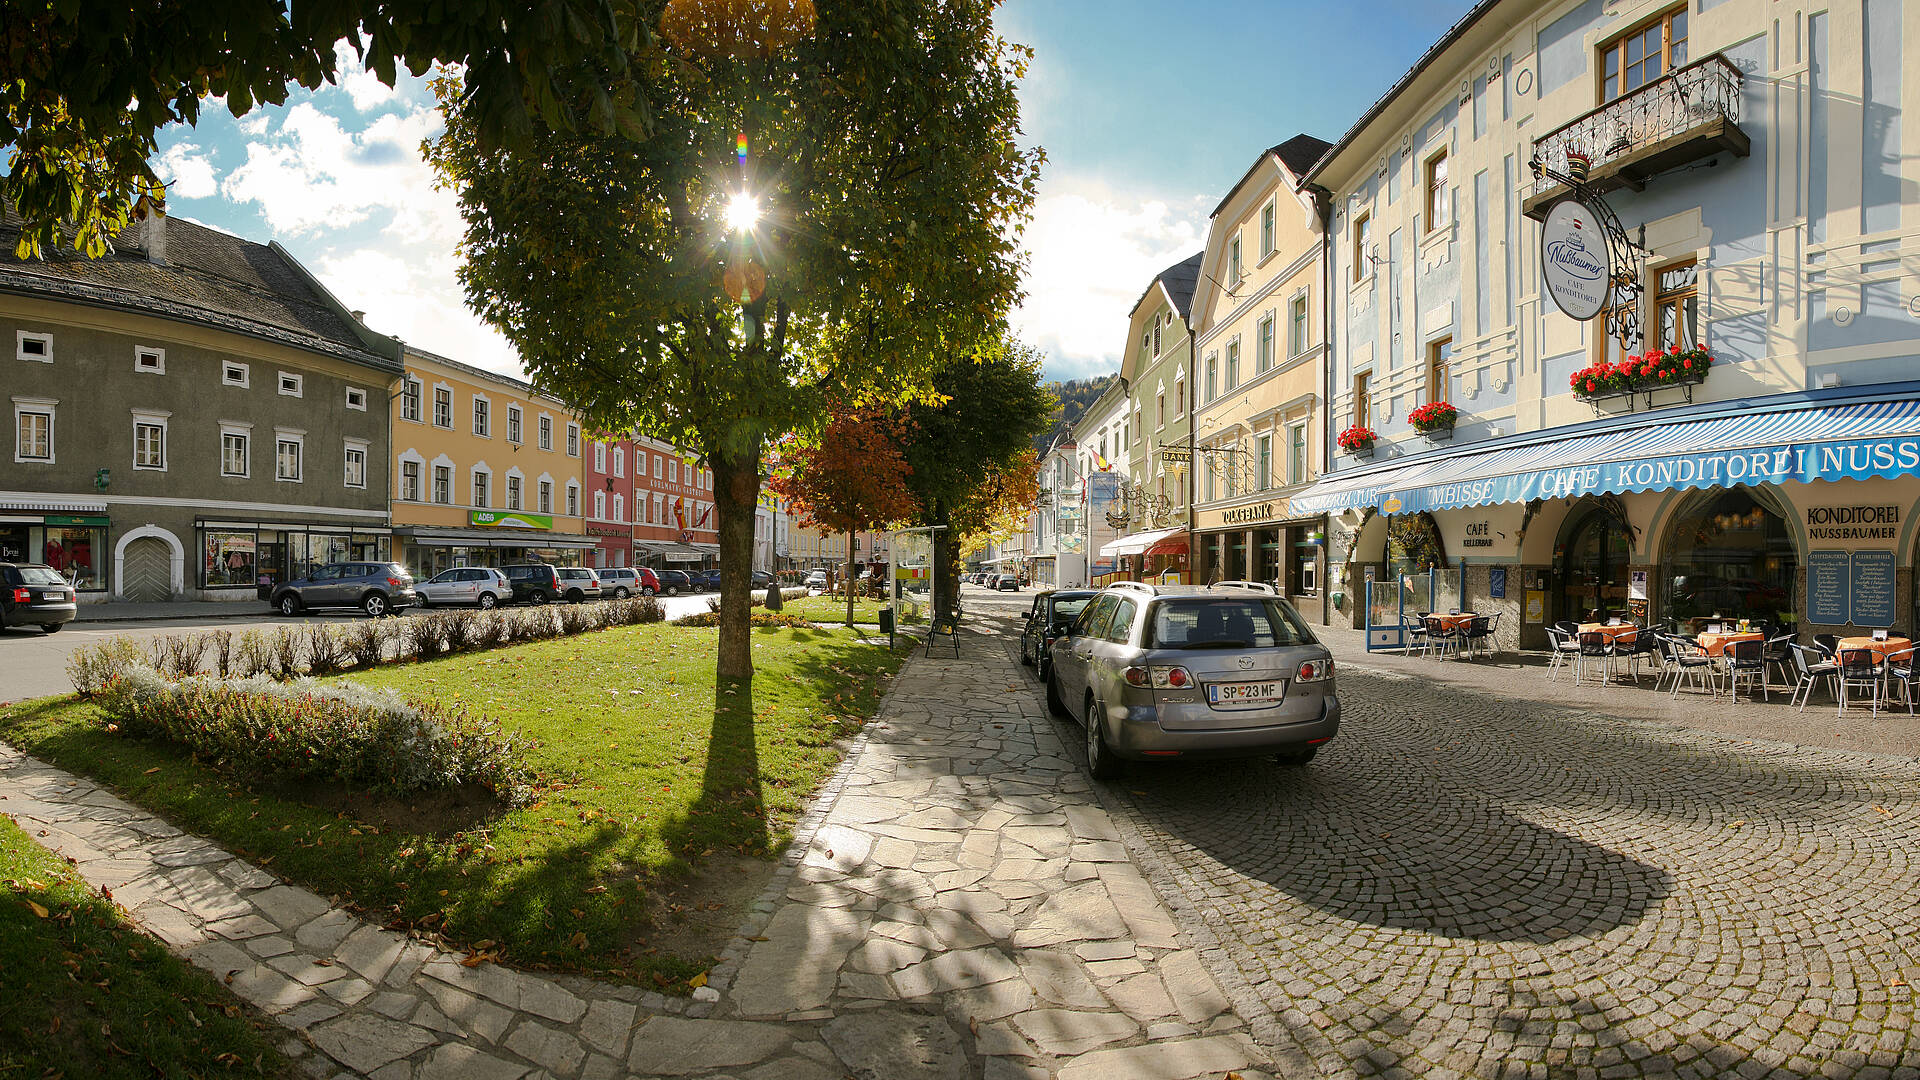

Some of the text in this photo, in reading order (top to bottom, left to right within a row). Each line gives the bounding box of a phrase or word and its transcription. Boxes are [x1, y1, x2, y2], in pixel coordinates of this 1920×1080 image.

[1550, 244, 1605, 275] Nußbaumer
[1555, 284, 1597, 304] KONDITOREI
[1163, 453, 1191, 461] BANK
[1616, 447, 1805, 486] KONDITOREI
[1821, 442, 1919, 473] NUSS
[478, 512, 495, 522] ADEG
[1222, 504, 1271, 522] VOLKSBANK
[1807, 506, 1899, 525] KONDITOREI
[1466, 520, 1488, 535] CAFÉ
[1809, 527, 1896, 540] NUSSBAUMER
[1463, 538, 1493, 547] KELLERBAR
[1223, 684, 1275, 698] SP 23 MF
